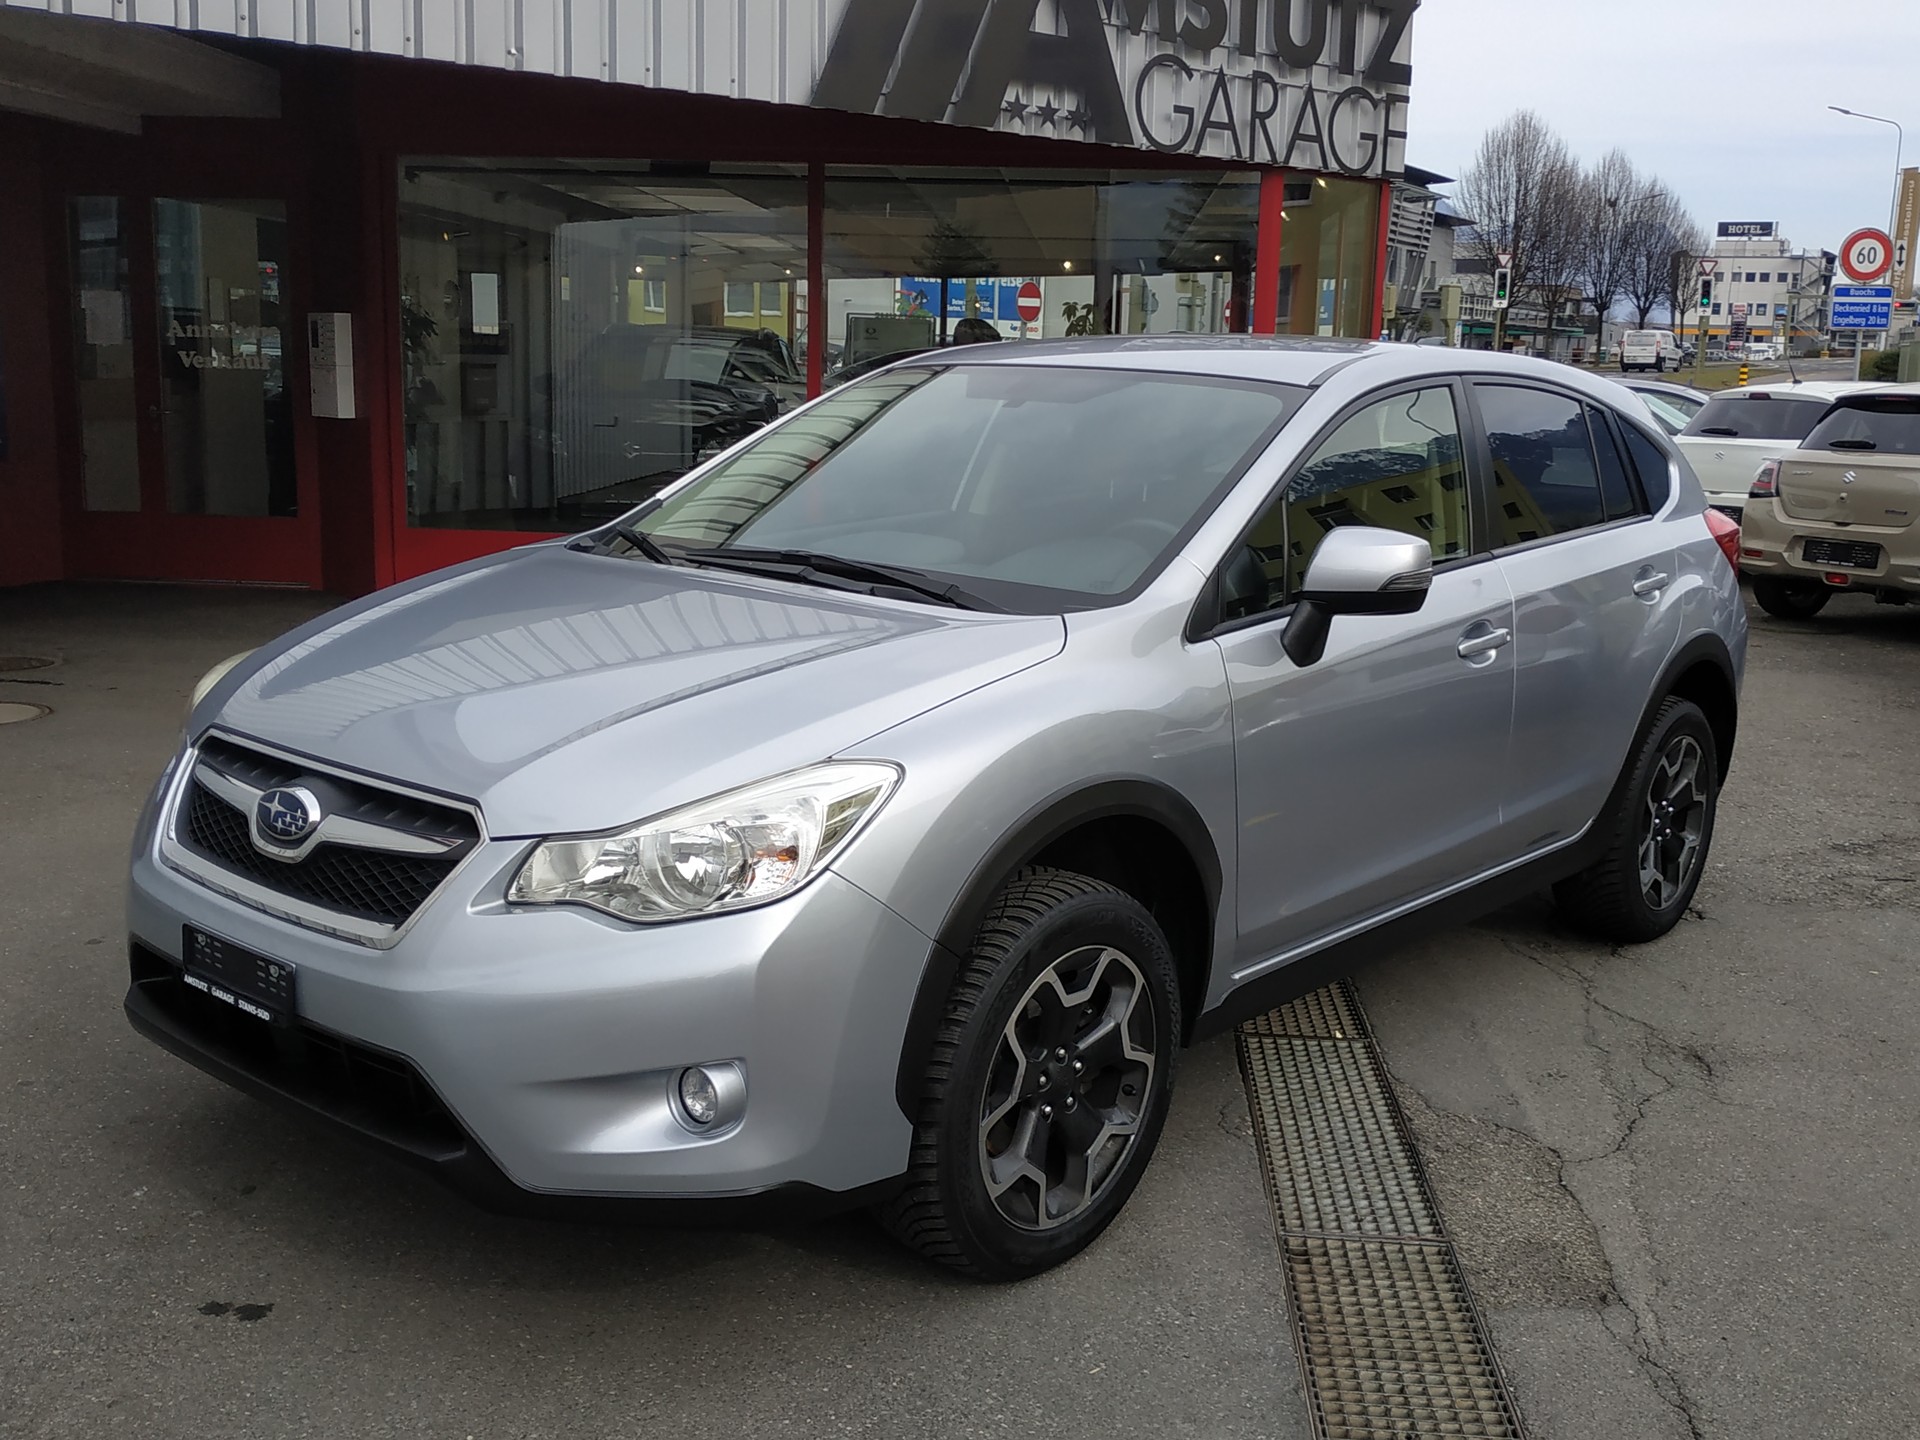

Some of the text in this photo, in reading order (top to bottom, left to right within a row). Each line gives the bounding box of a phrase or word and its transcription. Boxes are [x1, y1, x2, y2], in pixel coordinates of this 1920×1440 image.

[1135, 53, 1411, 178] GARAGE
[1728, 225, 1762, 234] HOTEL
[1856, 246, 1877, 265] 60
[1849, 288, 1876, 296] Buochs
[1834, 304, 1888, 313] Beckenried 8 km
[1833, 316, 1887, 326] Engelberg 20 km
[184, 974, 208, 992] AMSTUTZ
[211, 986, 235, 1005] GARAGE
